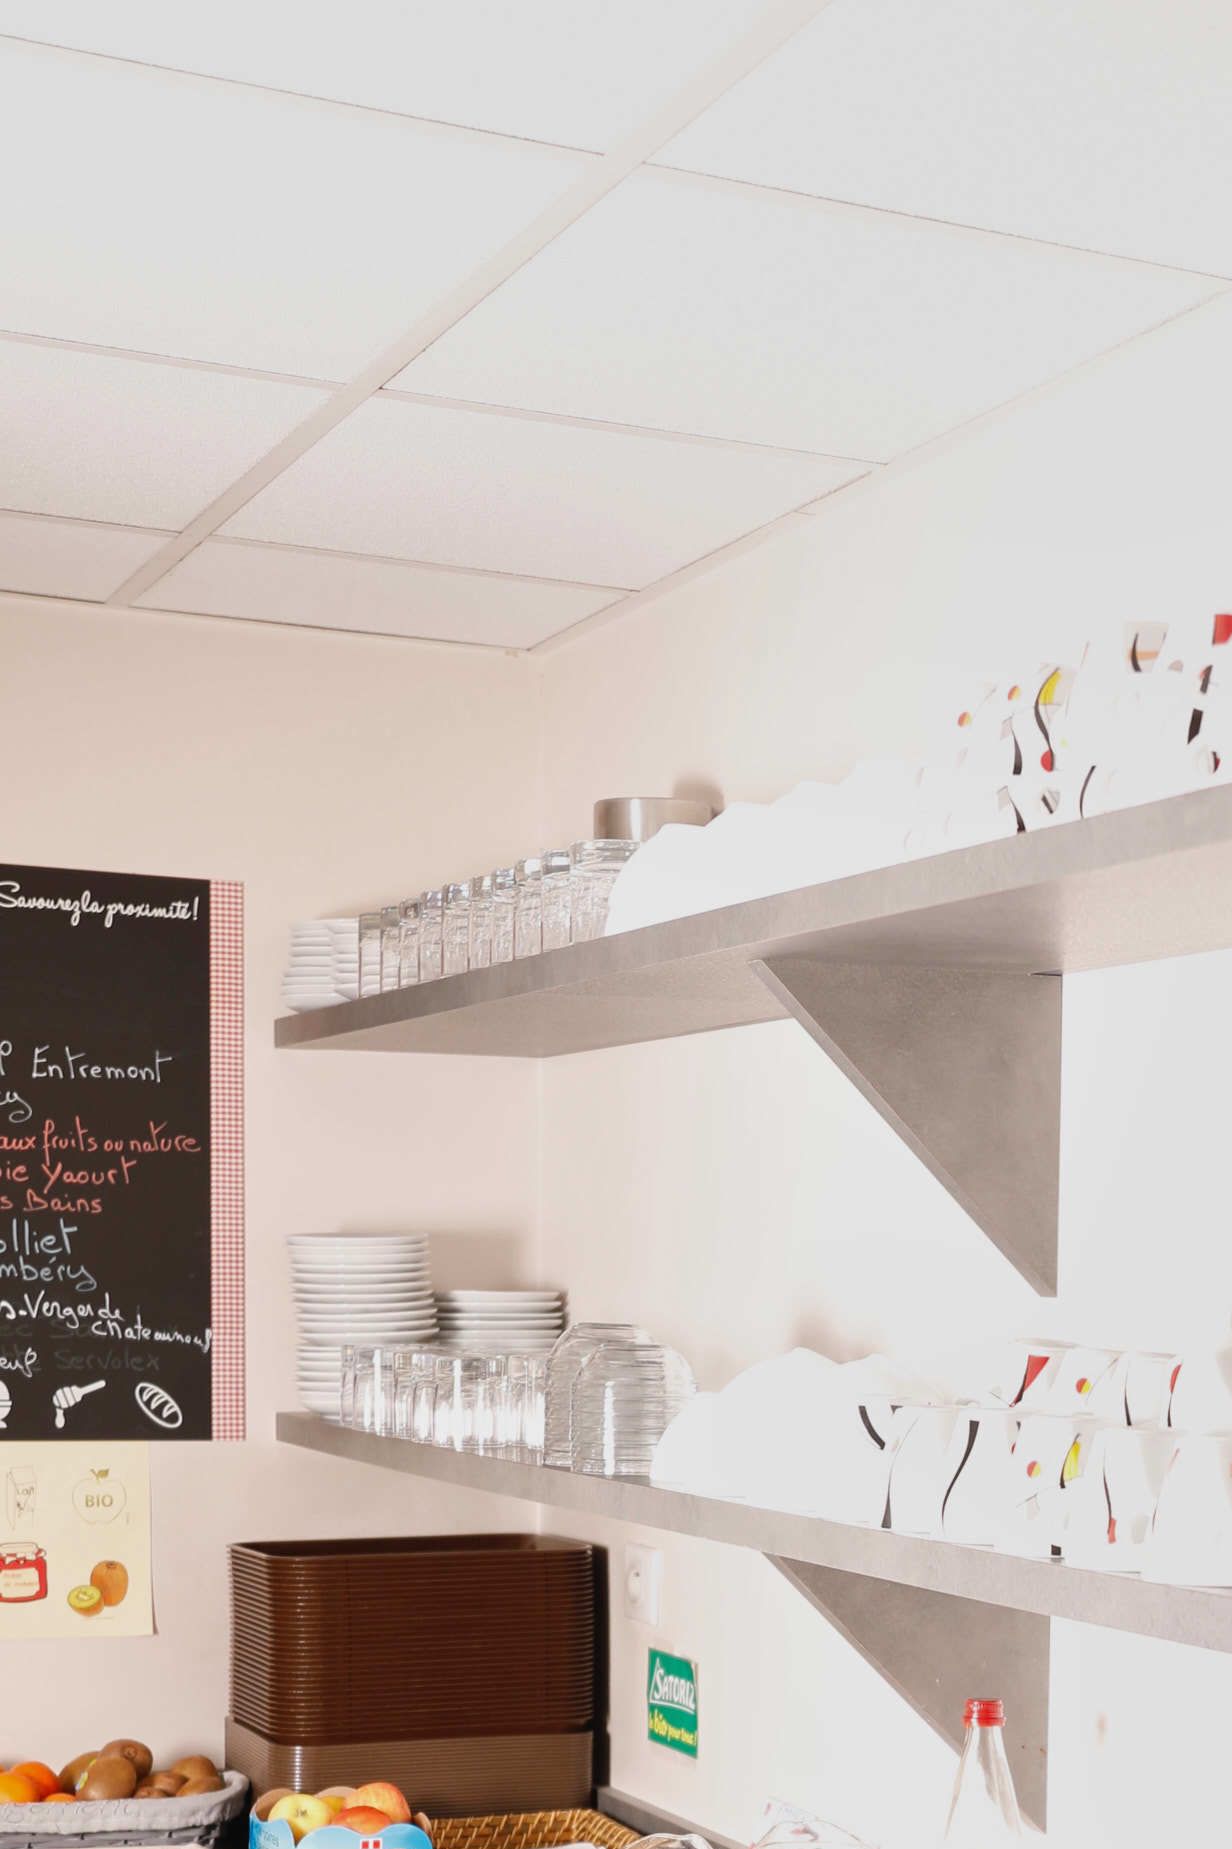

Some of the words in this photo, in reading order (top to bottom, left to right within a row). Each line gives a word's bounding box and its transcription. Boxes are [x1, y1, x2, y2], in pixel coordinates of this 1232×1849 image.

[32, 1044, 173, 1084] Entremont
[43, 1116, 98, 1167] fruits
[103, 1137, 124, 1153] ou
[130, 1120, 202, 1153] nature
[41, 1156, 138, 1195] Yaourt
[23, 1188, 103, 1215] Bains
[84, 1494, 114, 1509] BIO
[653, 1668, 696, 1711] SATORIZ
